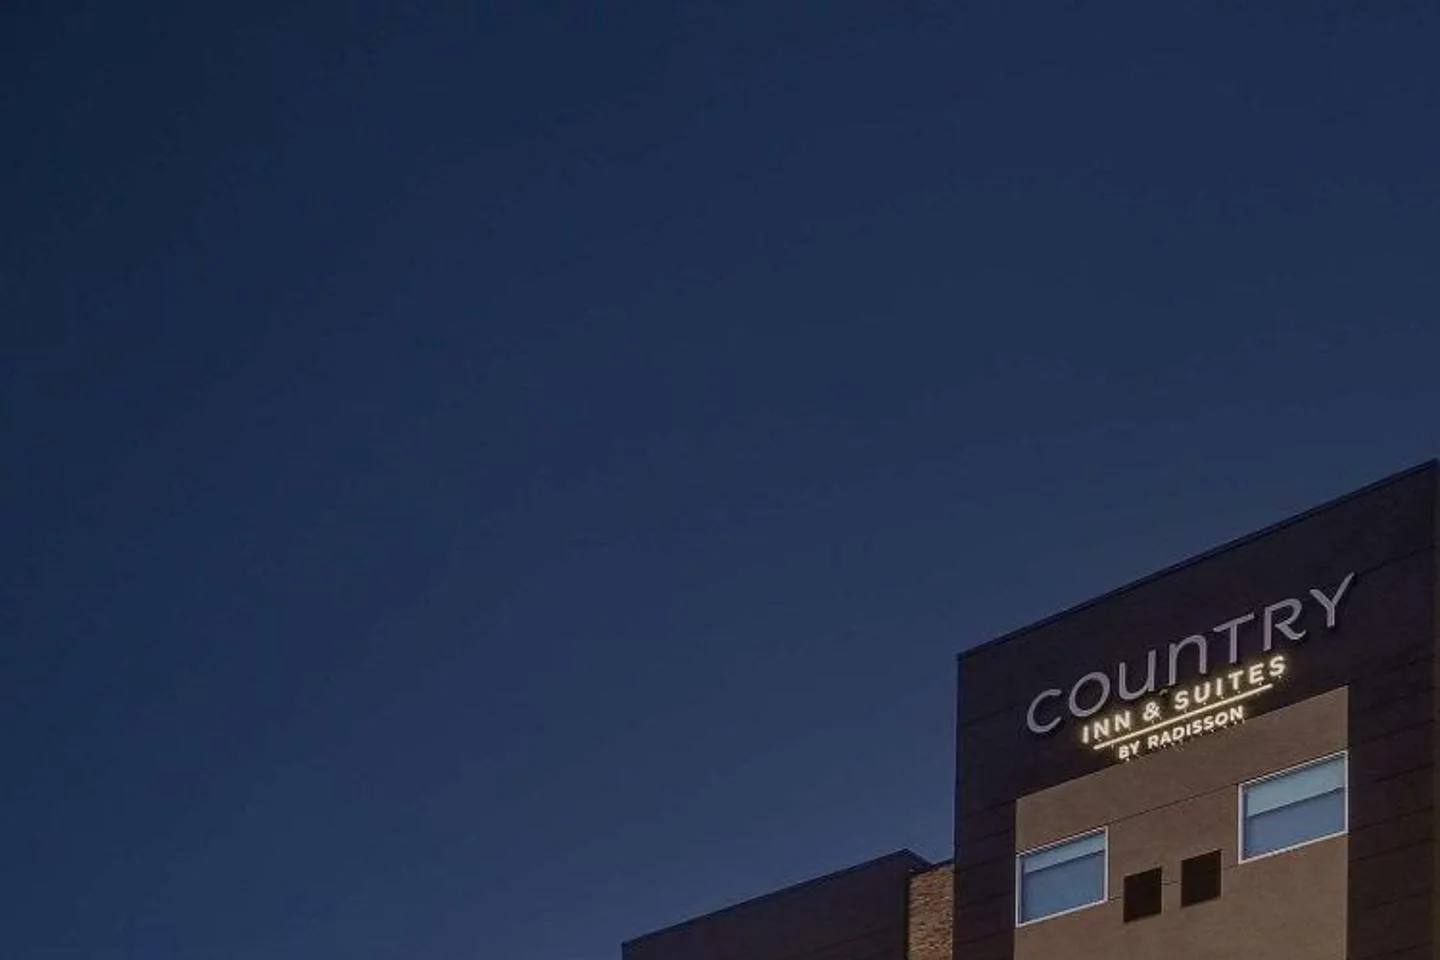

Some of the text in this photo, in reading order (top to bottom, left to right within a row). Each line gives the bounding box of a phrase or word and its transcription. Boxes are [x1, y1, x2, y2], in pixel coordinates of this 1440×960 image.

[1026, 571, 1355, 734] COUNTRY
[1081, 655, 1287, 745] INN & SUITES
[1118, 705, 1244, 760] BY RADISSON
